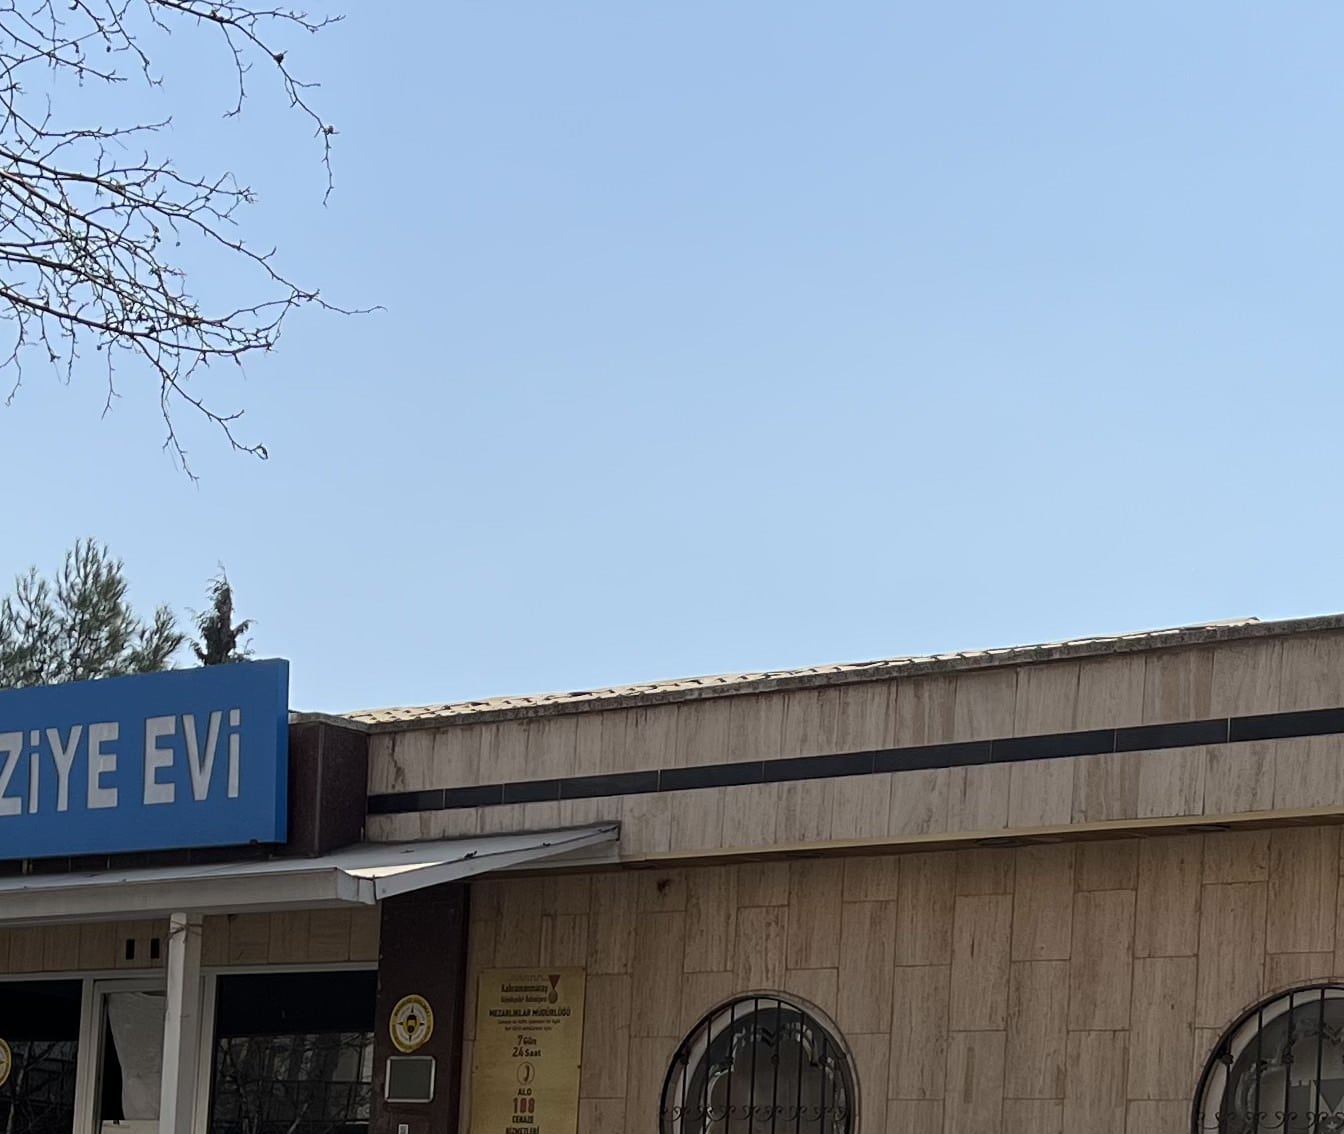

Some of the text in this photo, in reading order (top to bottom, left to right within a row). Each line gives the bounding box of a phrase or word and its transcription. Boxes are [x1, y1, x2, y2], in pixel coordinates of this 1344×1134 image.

[517, 1035, 537, 1046] 7 Gün
[512, 1047, 542, 1058] 24 Saat
[517, 1088, 533, 1096] ALO
